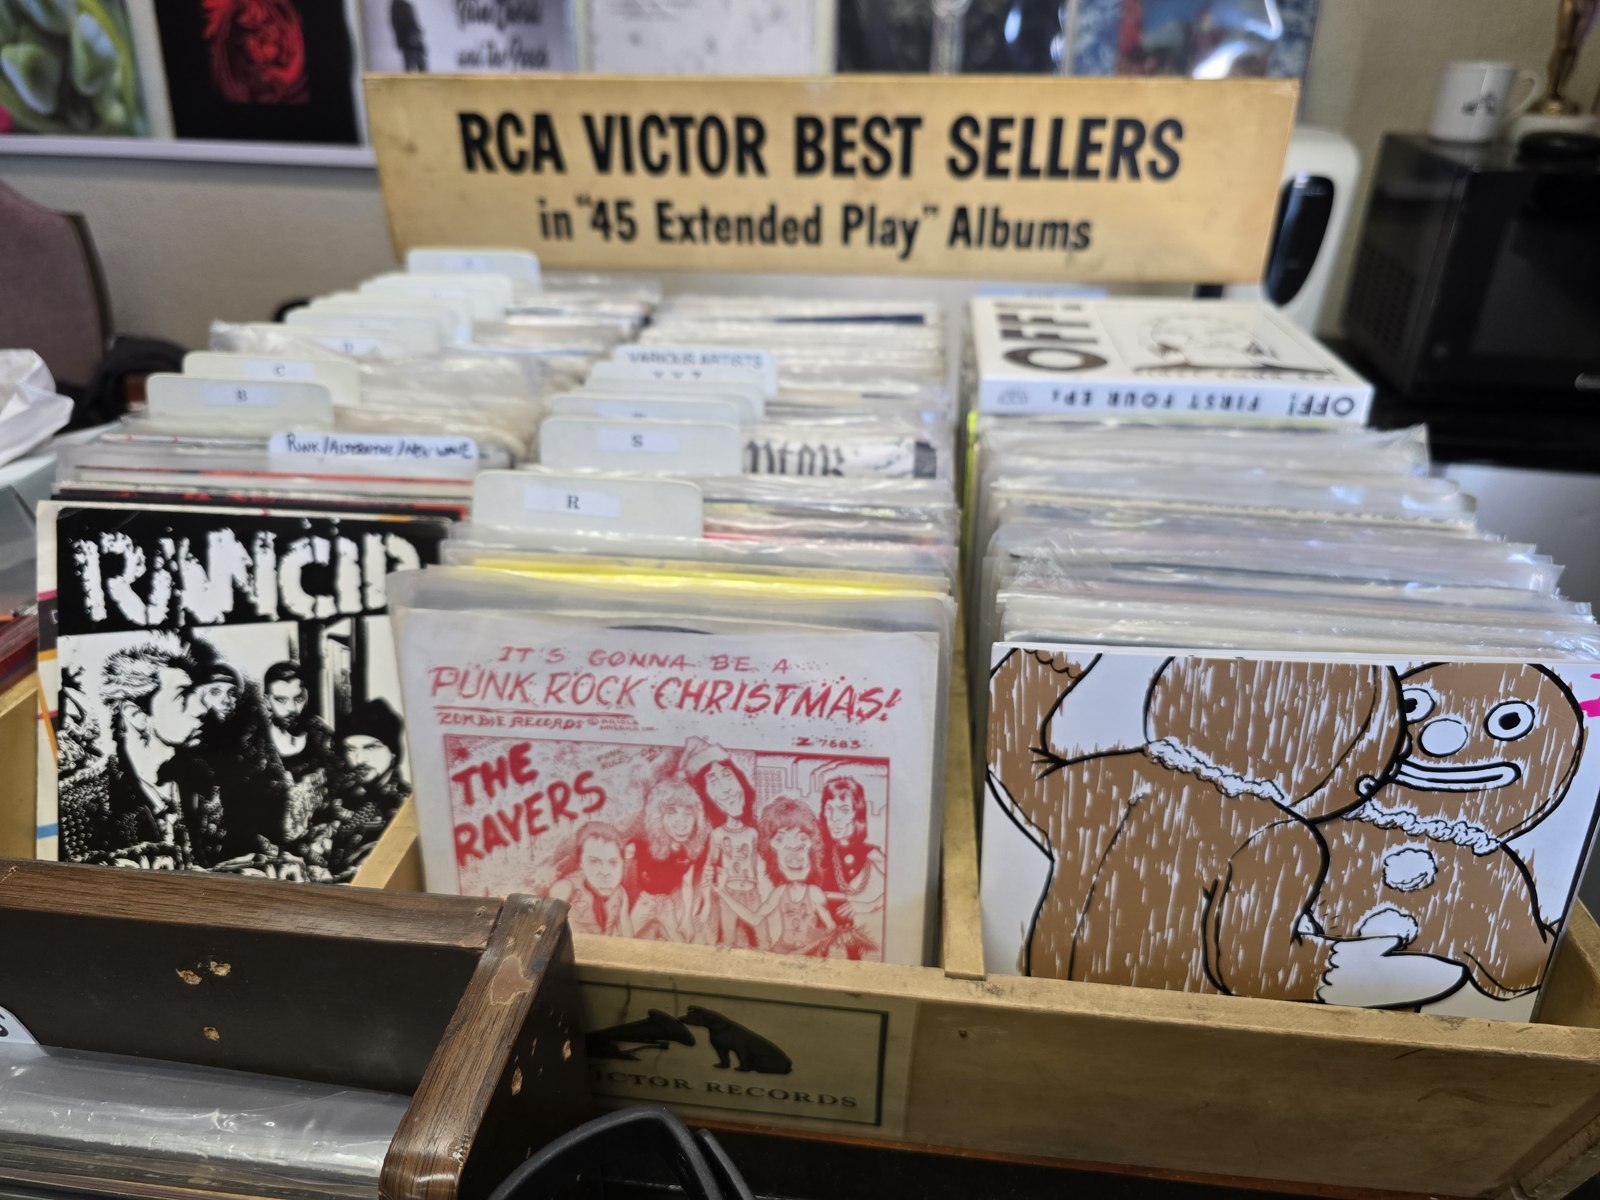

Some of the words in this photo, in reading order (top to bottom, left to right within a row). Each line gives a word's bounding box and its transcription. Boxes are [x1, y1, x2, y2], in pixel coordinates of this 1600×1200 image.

[458, 111, 566, 174] RCA
[583, 113, 767, 177] VICTOR
[794, 114, 922, 178] BEST
[947, 115, 1184, 182] SELLERS
[538, 197, 573, 242] in
[656, 202, 822, 246] Extended
[947, 205, 1092, 252] Albums
[235, 388, 248, 403] B
[1106, 391, 1175, 408] FOUR
[1188, 395, 1259, 412] FIRST
[1287, 393, 1355, 417] OFF!
[631, 434, 643, 448] S
[567, 494, 580, 510] R
[588, 649, 695, 669] GONNA
[710, 653, 752, 673] BE
[772, 658, 790, 674] A
[431, 664, 537, 704] PUNK
[544, 671, 648, 707] ROCK
[653, 675, 903, 724] CHRISTMAS!
[437, 711, 506, 727] ZOMBIE
[509, 713, 584, 730] RECORDS
[451, 742, 540, 806] THE
[453, 770, 607, 867] RAVERS
[704, 1080, 858, 1108] RECORDS
